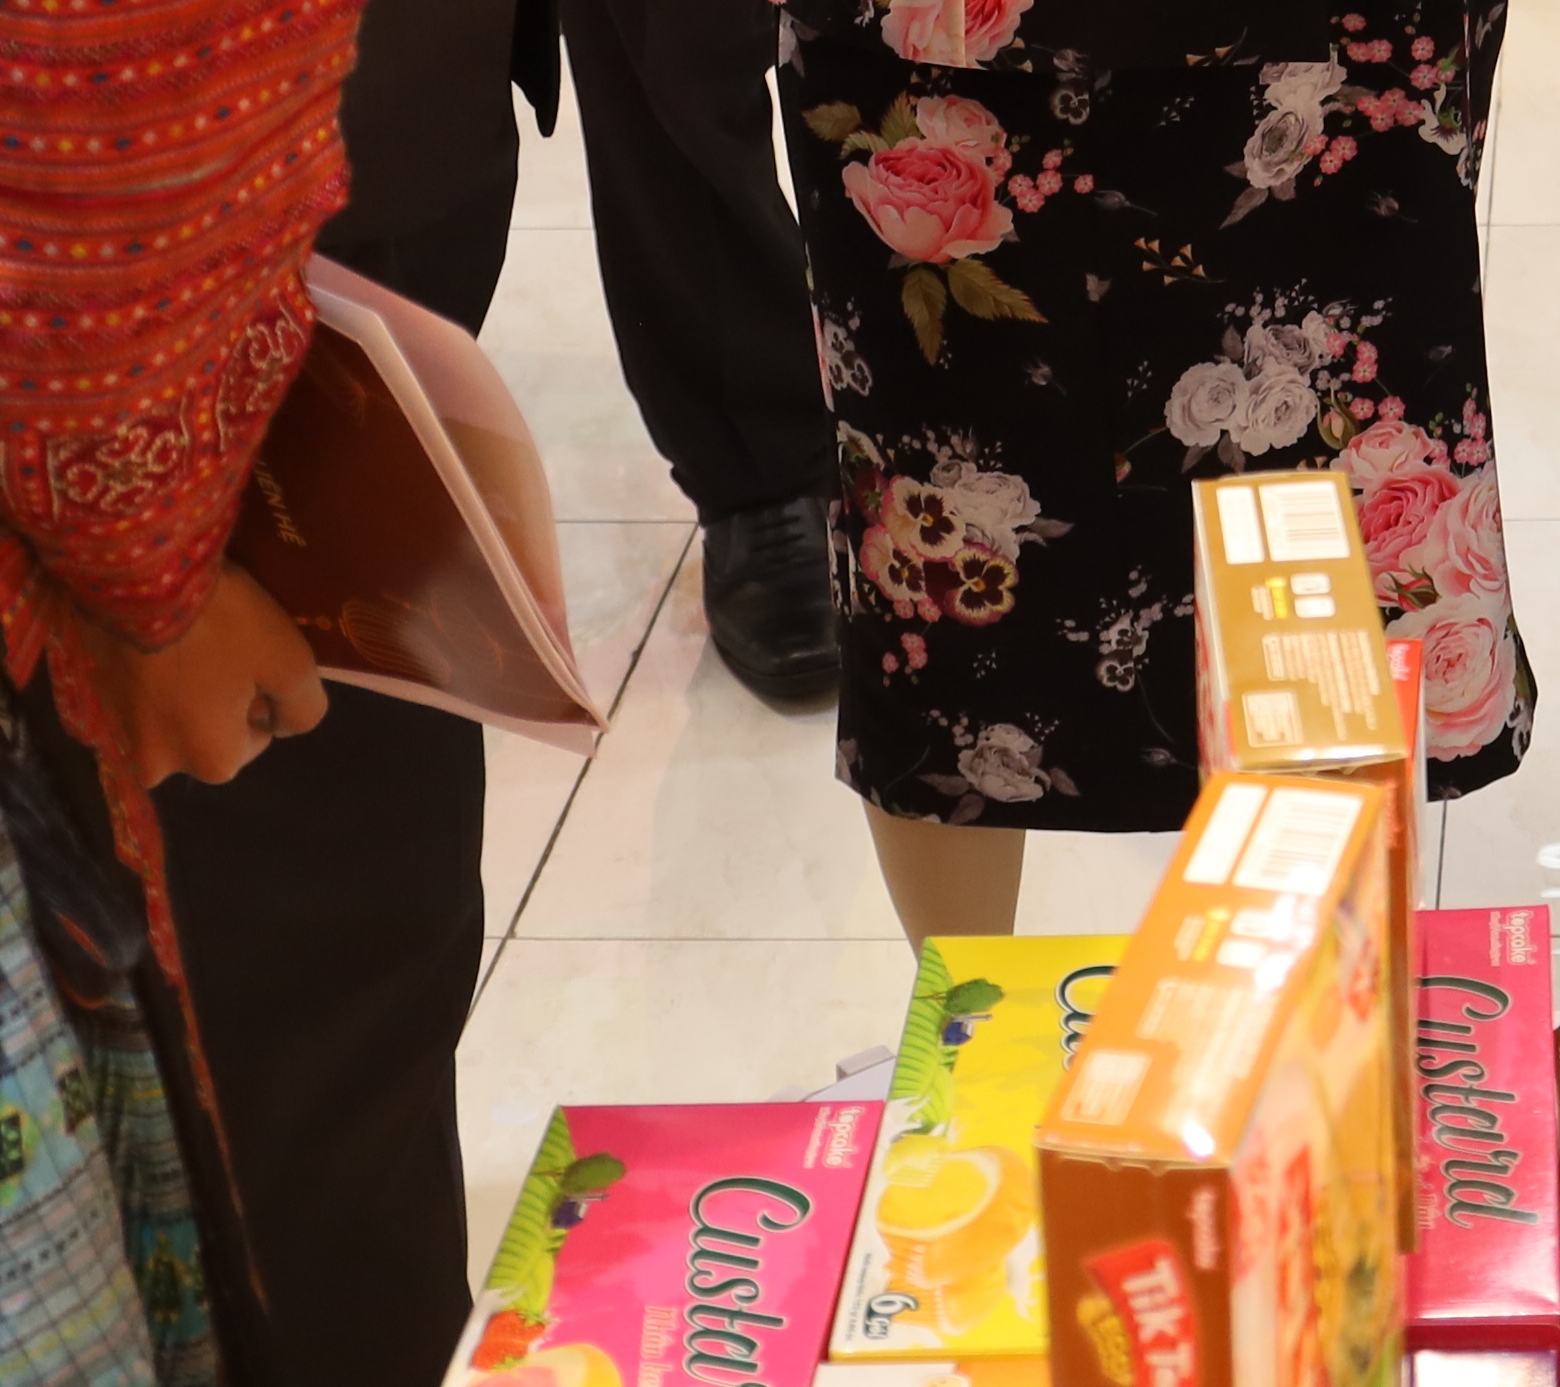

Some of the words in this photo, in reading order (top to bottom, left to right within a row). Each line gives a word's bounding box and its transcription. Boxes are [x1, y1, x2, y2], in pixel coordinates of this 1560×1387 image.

[1416, 975, 1541, 1229] Custard
[683, 1176, 812, 1387] Custa
[868, 1291, 920, 1316] 6
